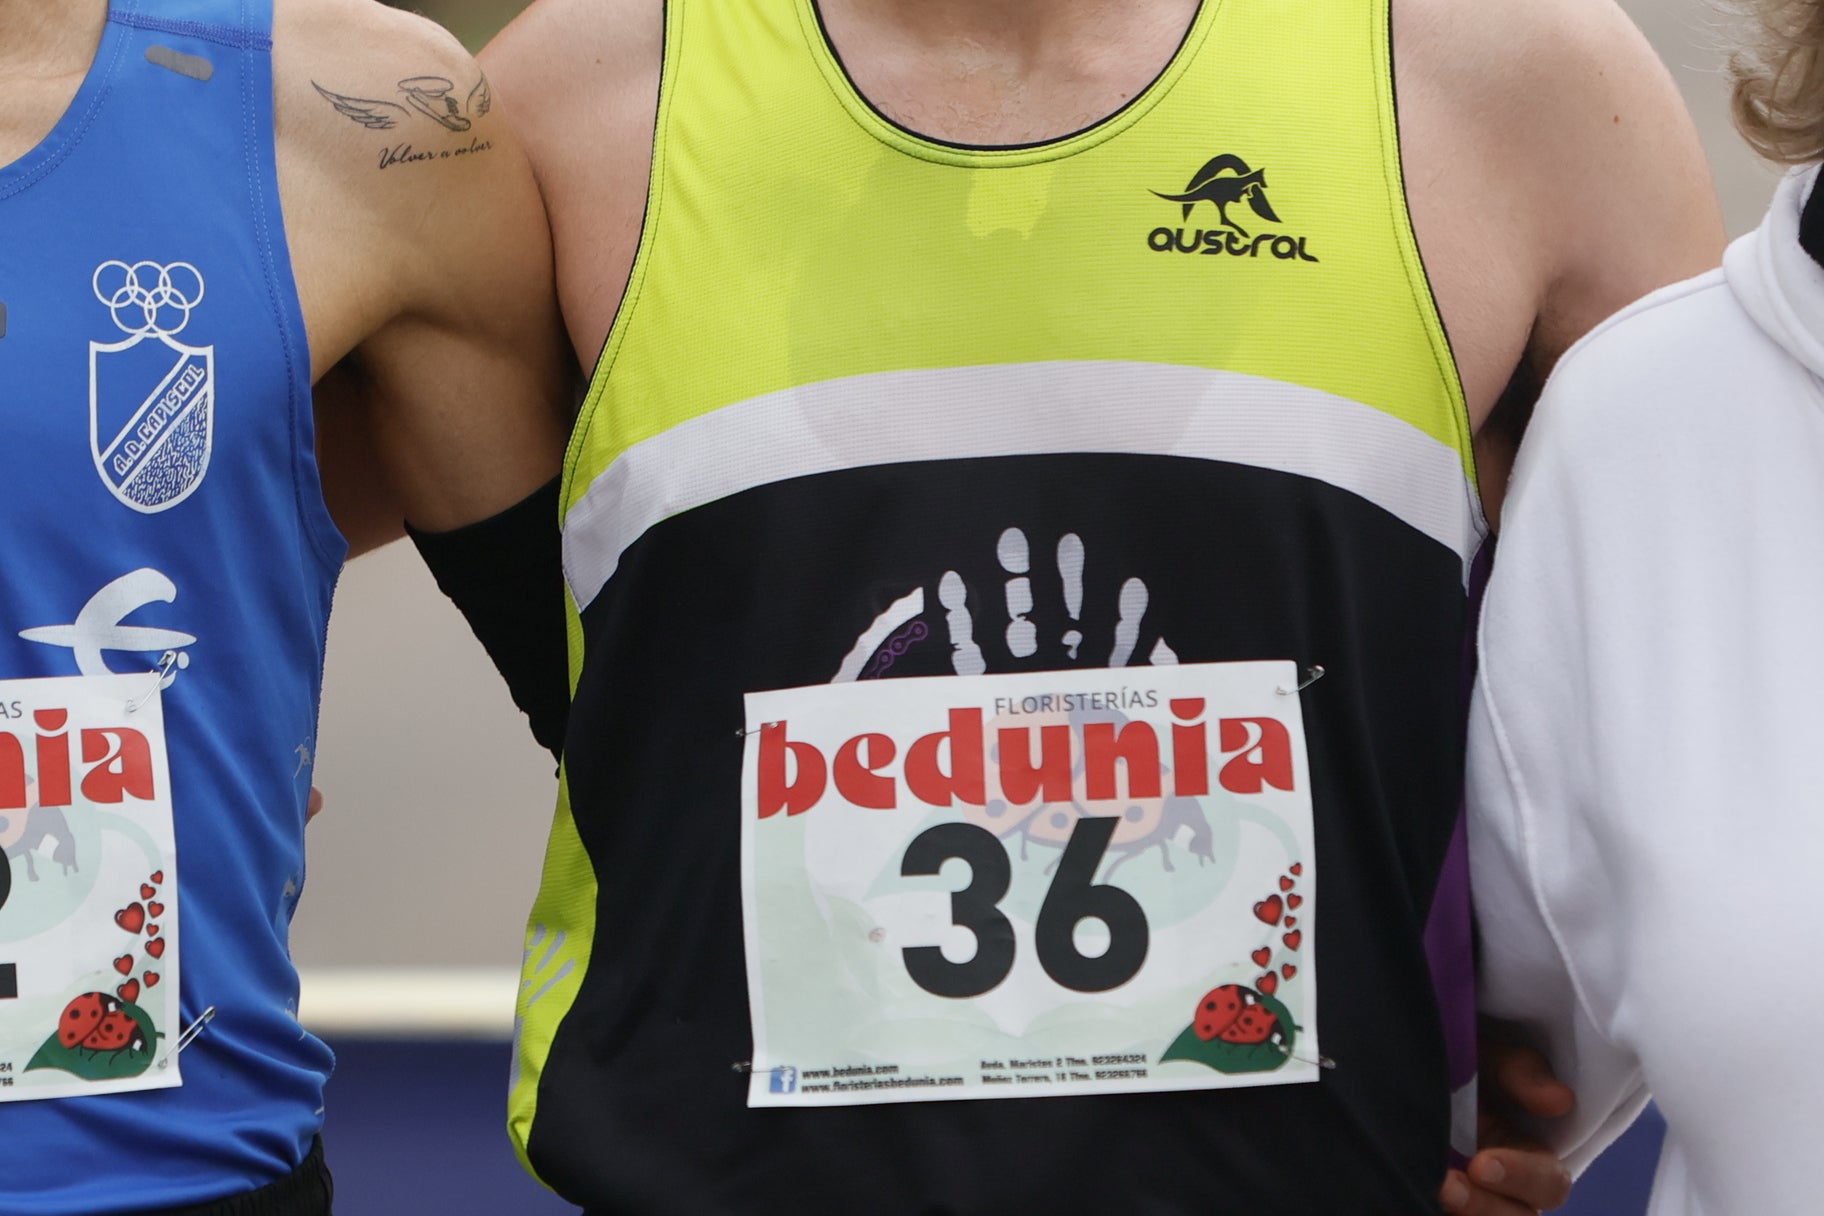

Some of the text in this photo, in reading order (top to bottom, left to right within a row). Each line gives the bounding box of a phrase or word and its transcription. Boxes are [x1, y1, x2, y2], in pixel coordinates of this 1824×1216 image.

[378, 137, 493, 169] Volver a volver
[1148, 227, 1320, 262] austral
[995, 689, 1159, 716] FLORISTERÍAS
[757, 697, 1295, 820] bedunia
[900, 816, 1149, 1000] 36
